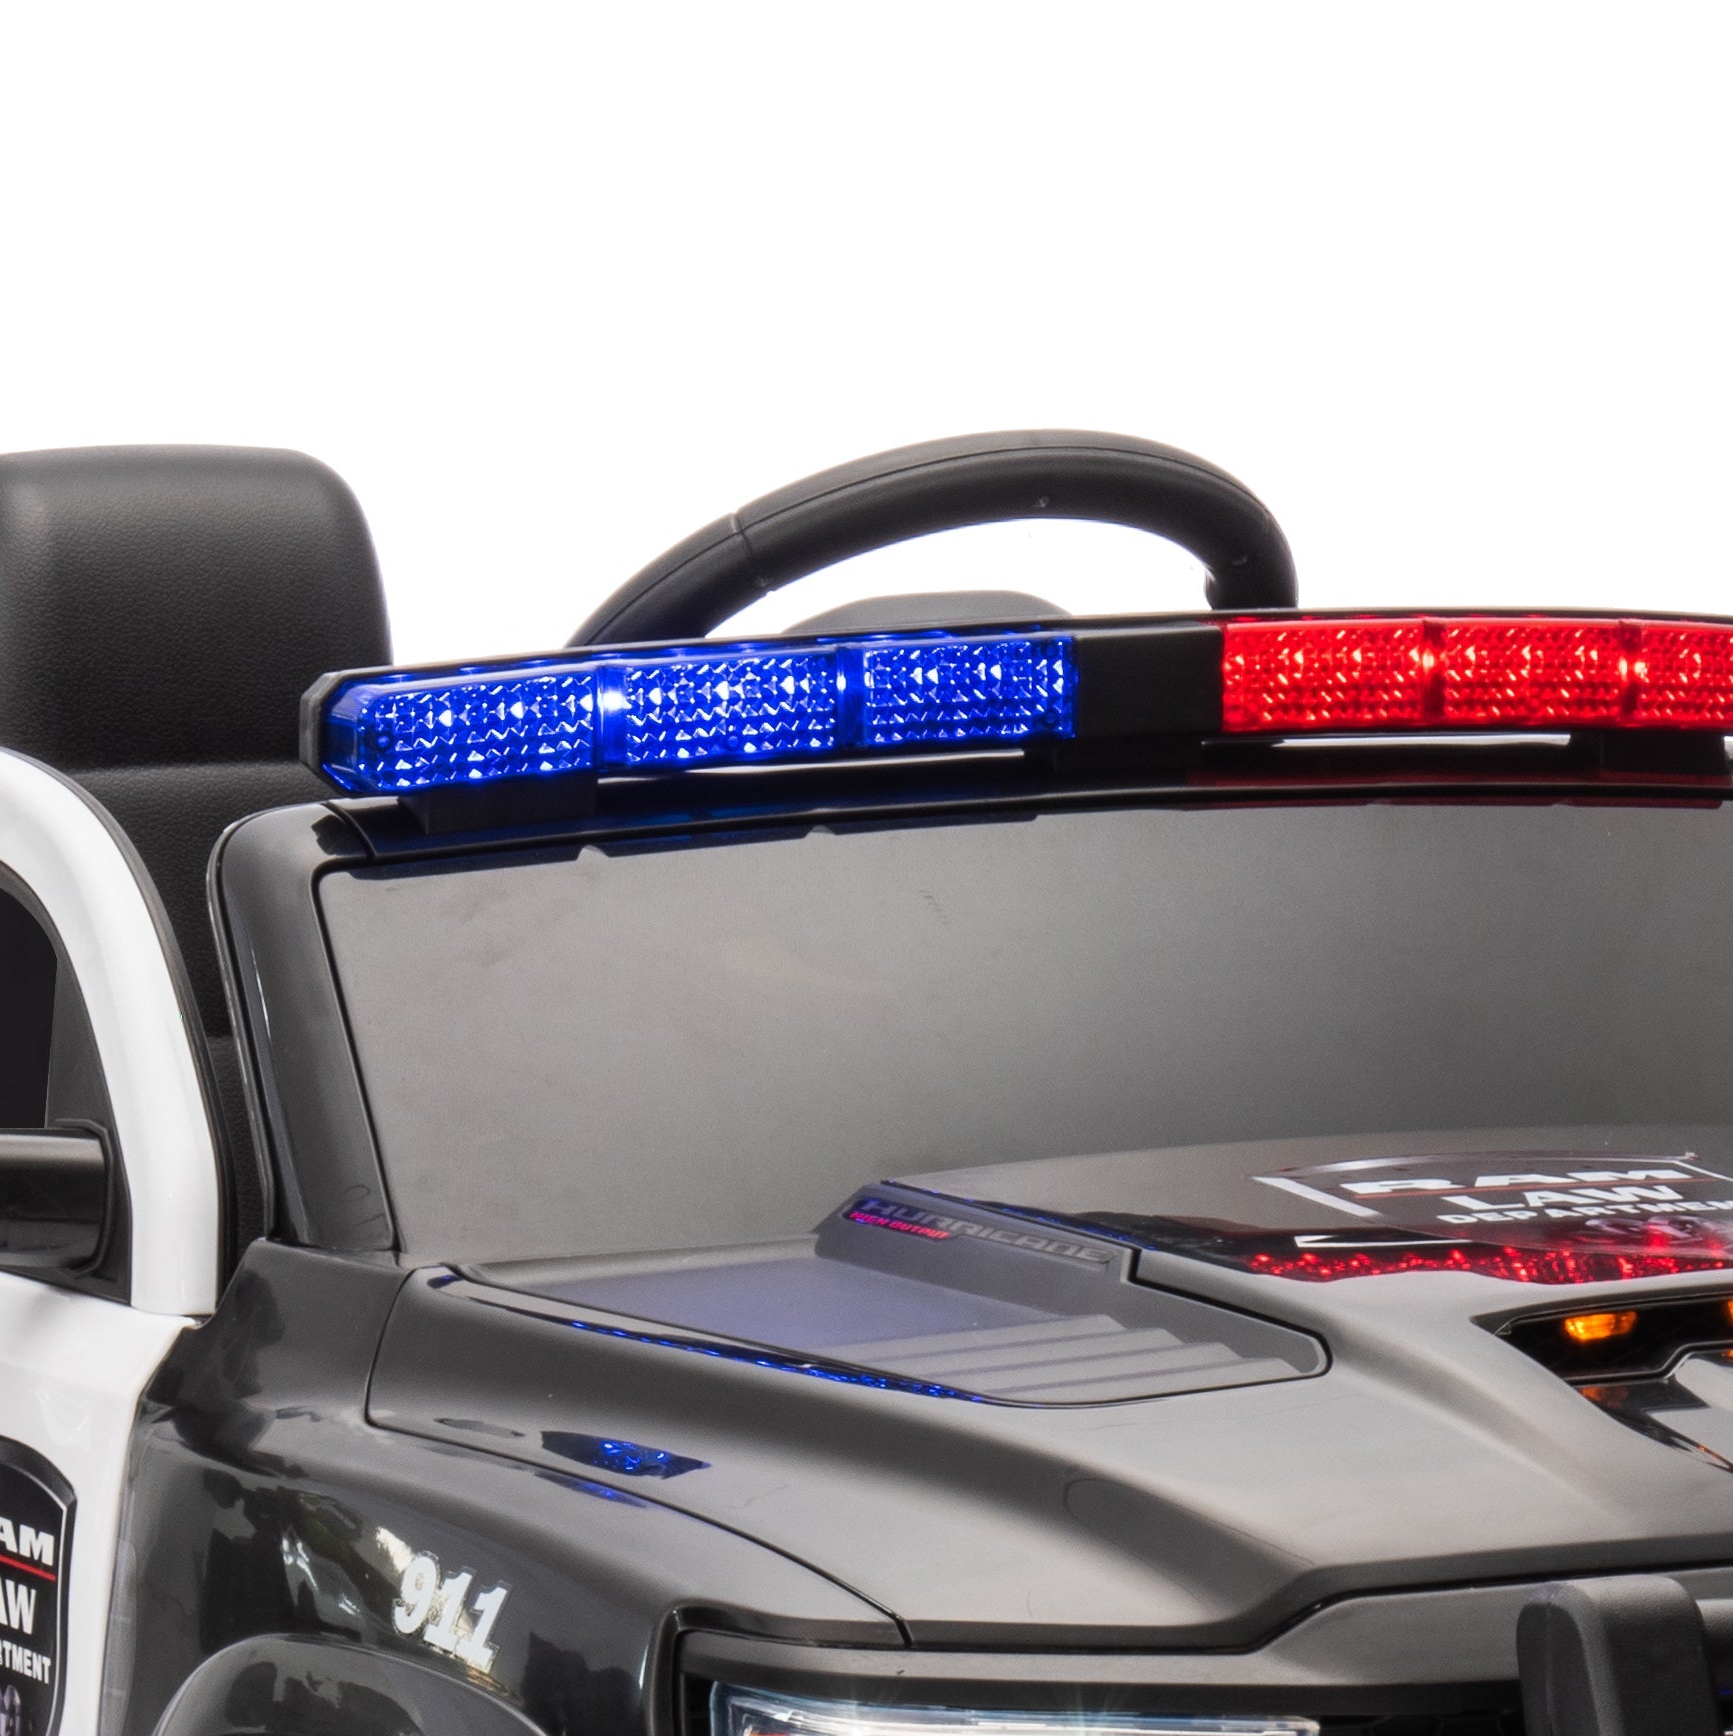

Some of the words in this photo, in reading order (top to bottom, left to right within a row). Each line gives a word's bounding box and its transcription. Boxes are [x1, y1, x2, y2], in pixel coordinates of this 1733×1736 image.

[1341, 1167, 1694, 1195] RAM
[1441, 1184, 1683, 1212] LAW
[394, 1555, 508, 1673] 911
